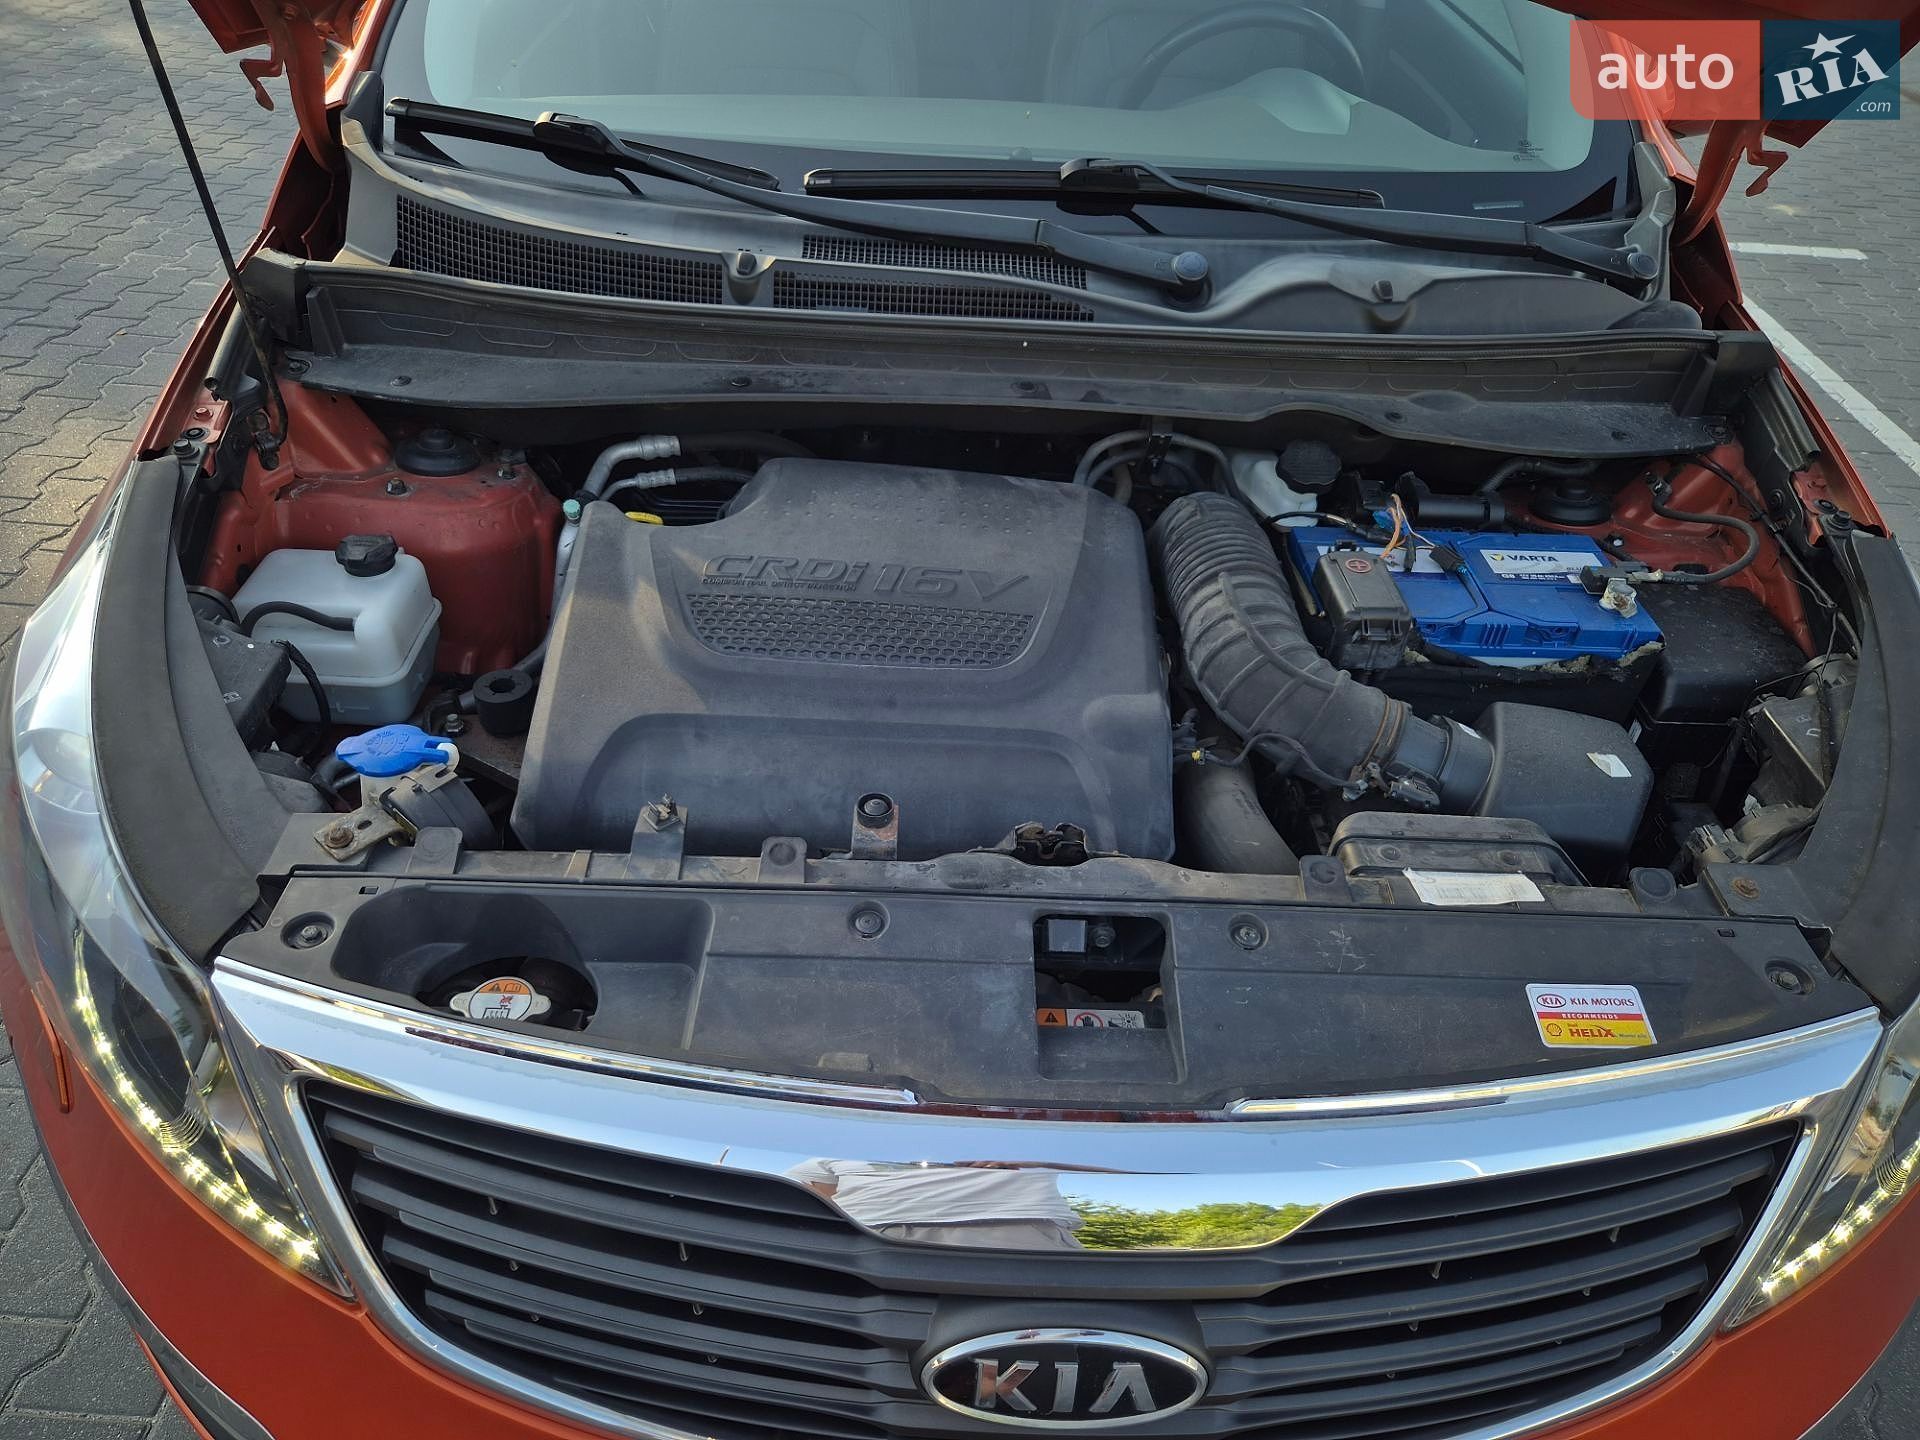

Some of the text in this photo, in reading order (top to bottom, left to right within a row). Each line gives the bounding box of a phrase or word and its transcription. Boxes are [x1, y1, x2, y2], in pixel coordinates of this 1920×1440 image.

[1506, 554, 1559, 562] VARTA
[1541, 996, 1563, 1006] KIA
[1570, 997, 1635, 1007] KIA MOTORS
[1568, 1028, 1616, 1038] HELIX
[973, 1358, 1157, 1413] KIA
